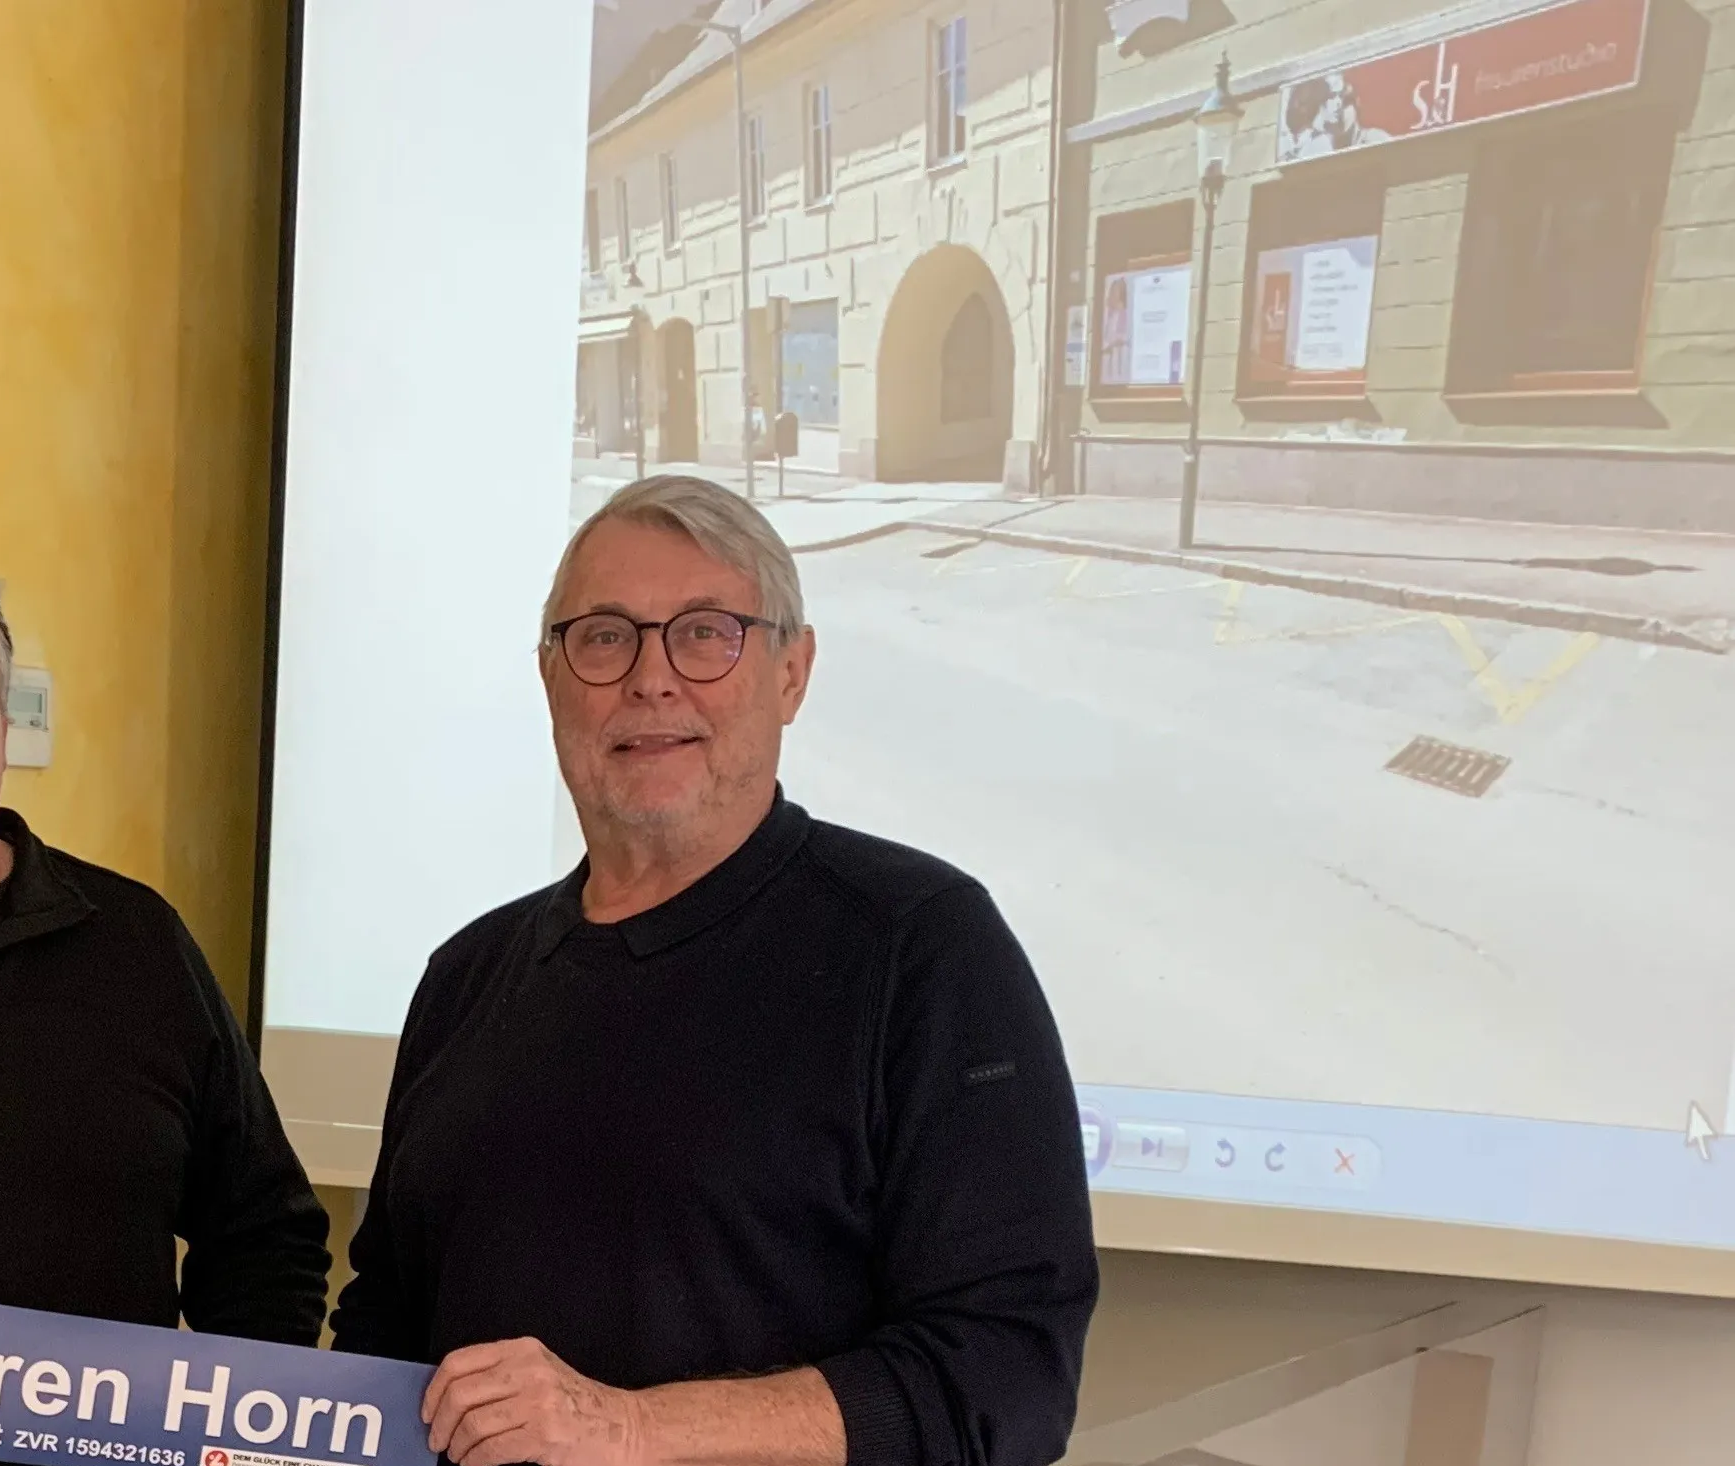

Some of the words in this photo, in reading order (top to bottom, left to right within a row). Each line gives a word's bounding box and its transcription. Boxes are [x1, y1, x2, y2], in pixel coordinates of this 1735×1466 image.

[164, 1359, 383, 1458] Horn
[13, 1430, 58, 1453] ZVR
[254, 1457, 280, 1466] GLÜCK
